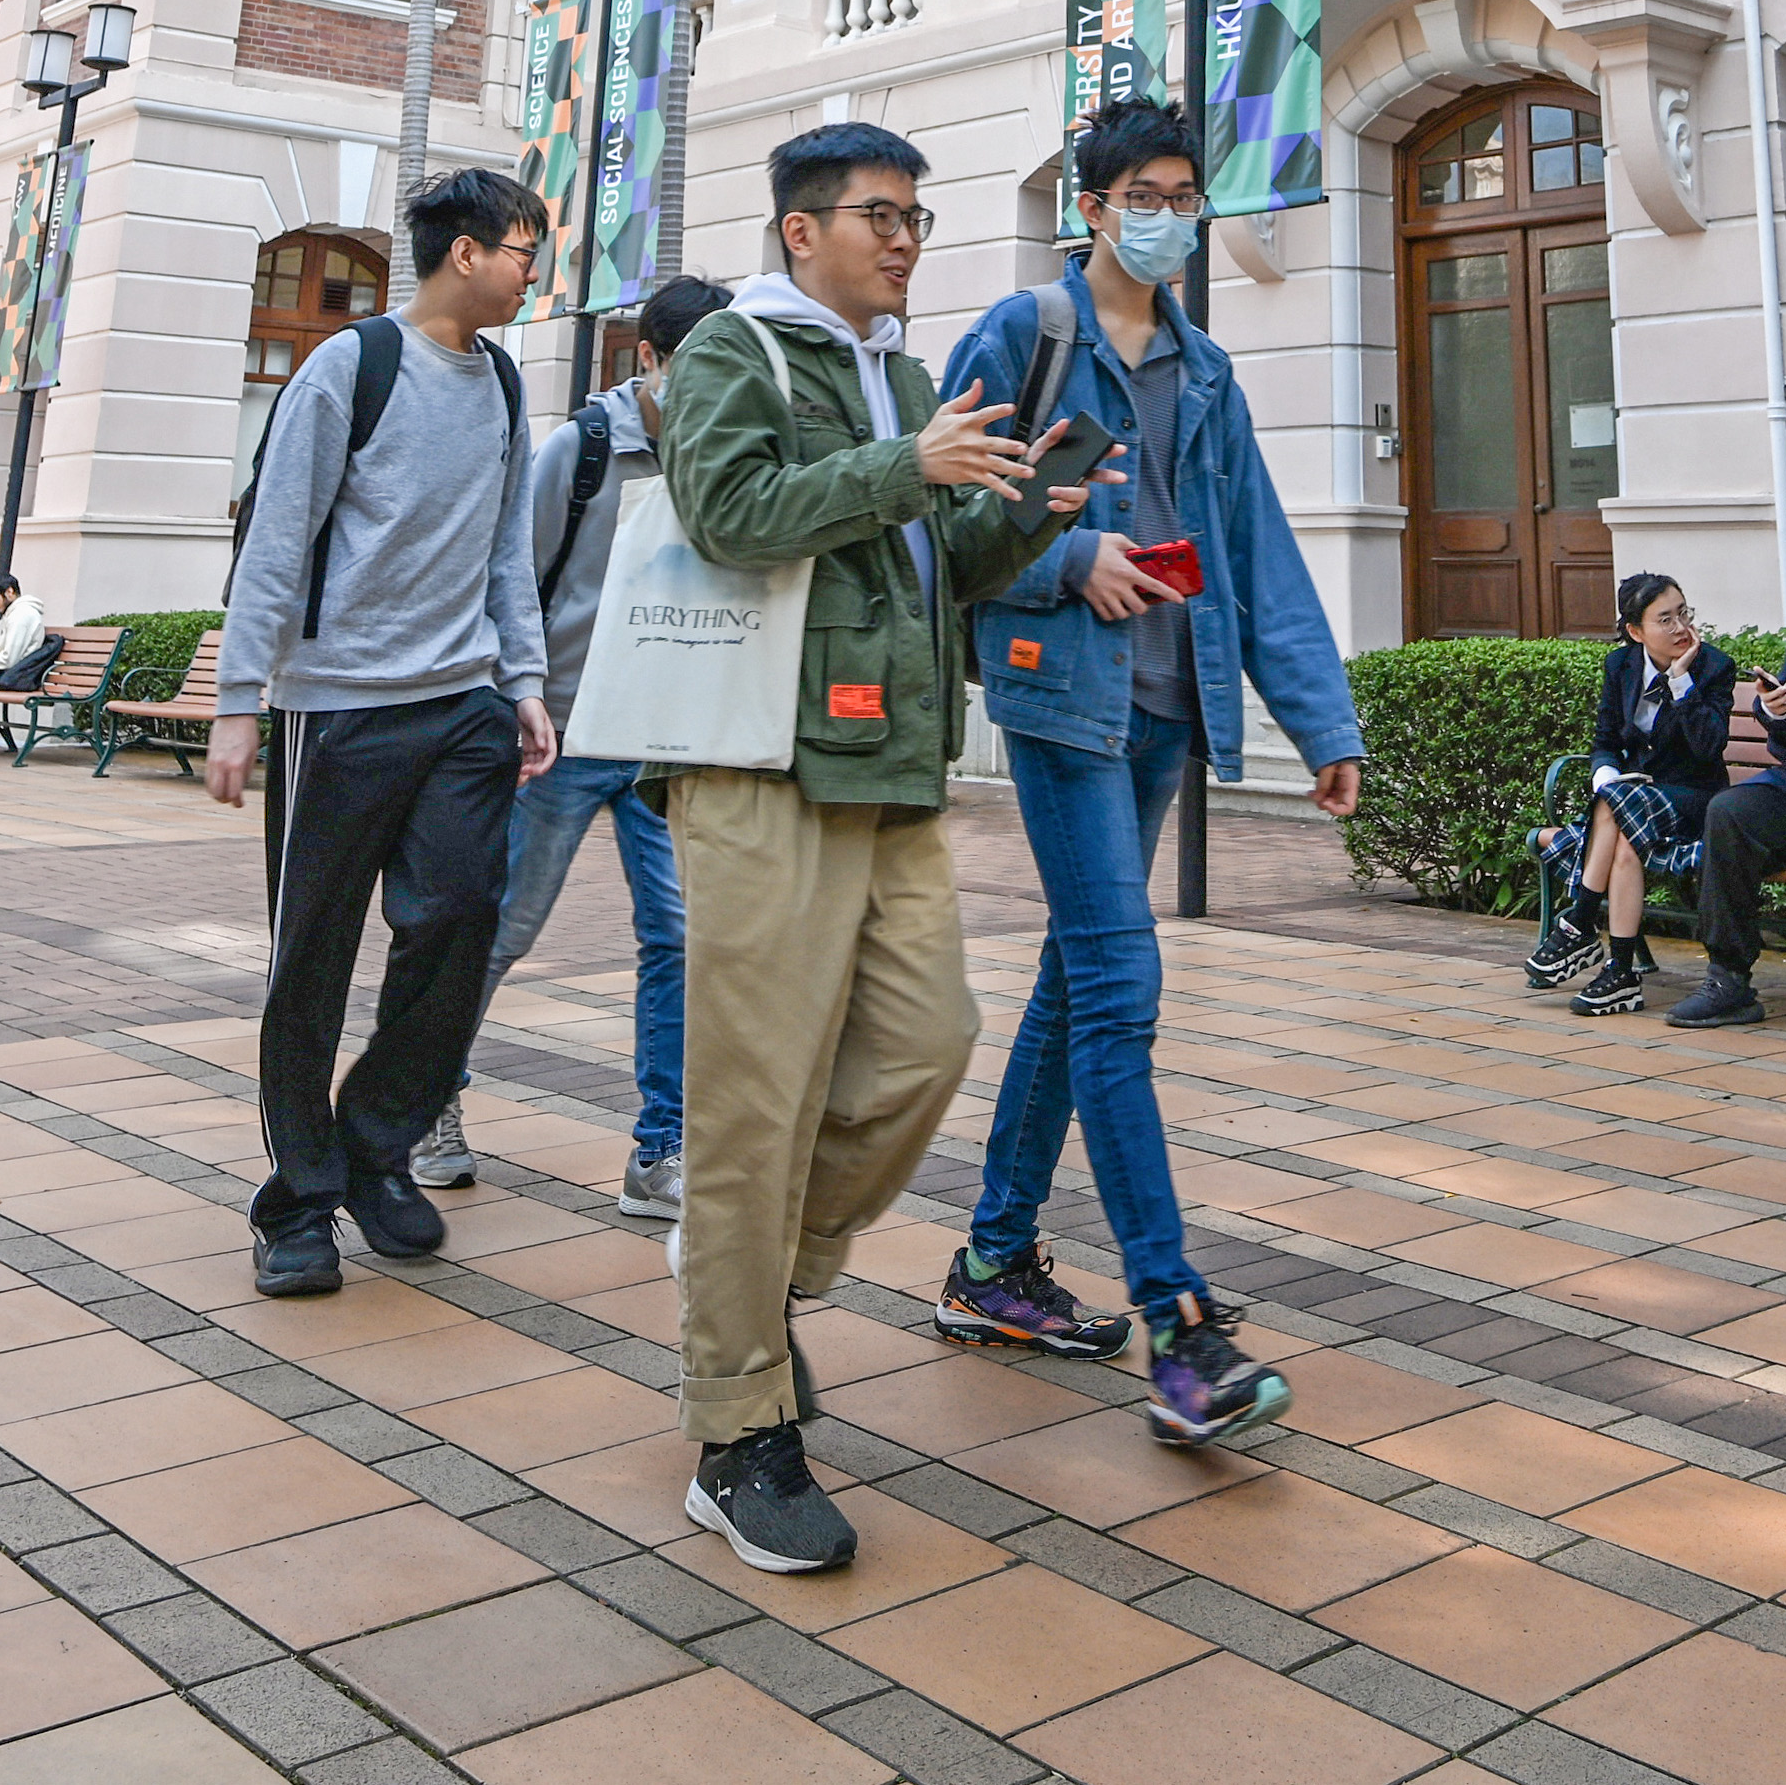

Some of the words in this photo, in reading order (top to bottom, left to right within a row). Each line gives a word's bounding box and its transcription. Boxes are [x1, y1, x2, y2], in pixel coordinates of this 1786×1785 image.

[528, 22, 551, 131] SCIENCE
[1072, 5, 1103, 198] VERSITY
[1108, 61, 1133, 102] ND
[13, 179, 26, 220] LAW
[47, 165, 69, 259] MEDICINE
[600, 132, 626, 225] SOCIAL
[628, 605, 762, 631] EVERYTHING
